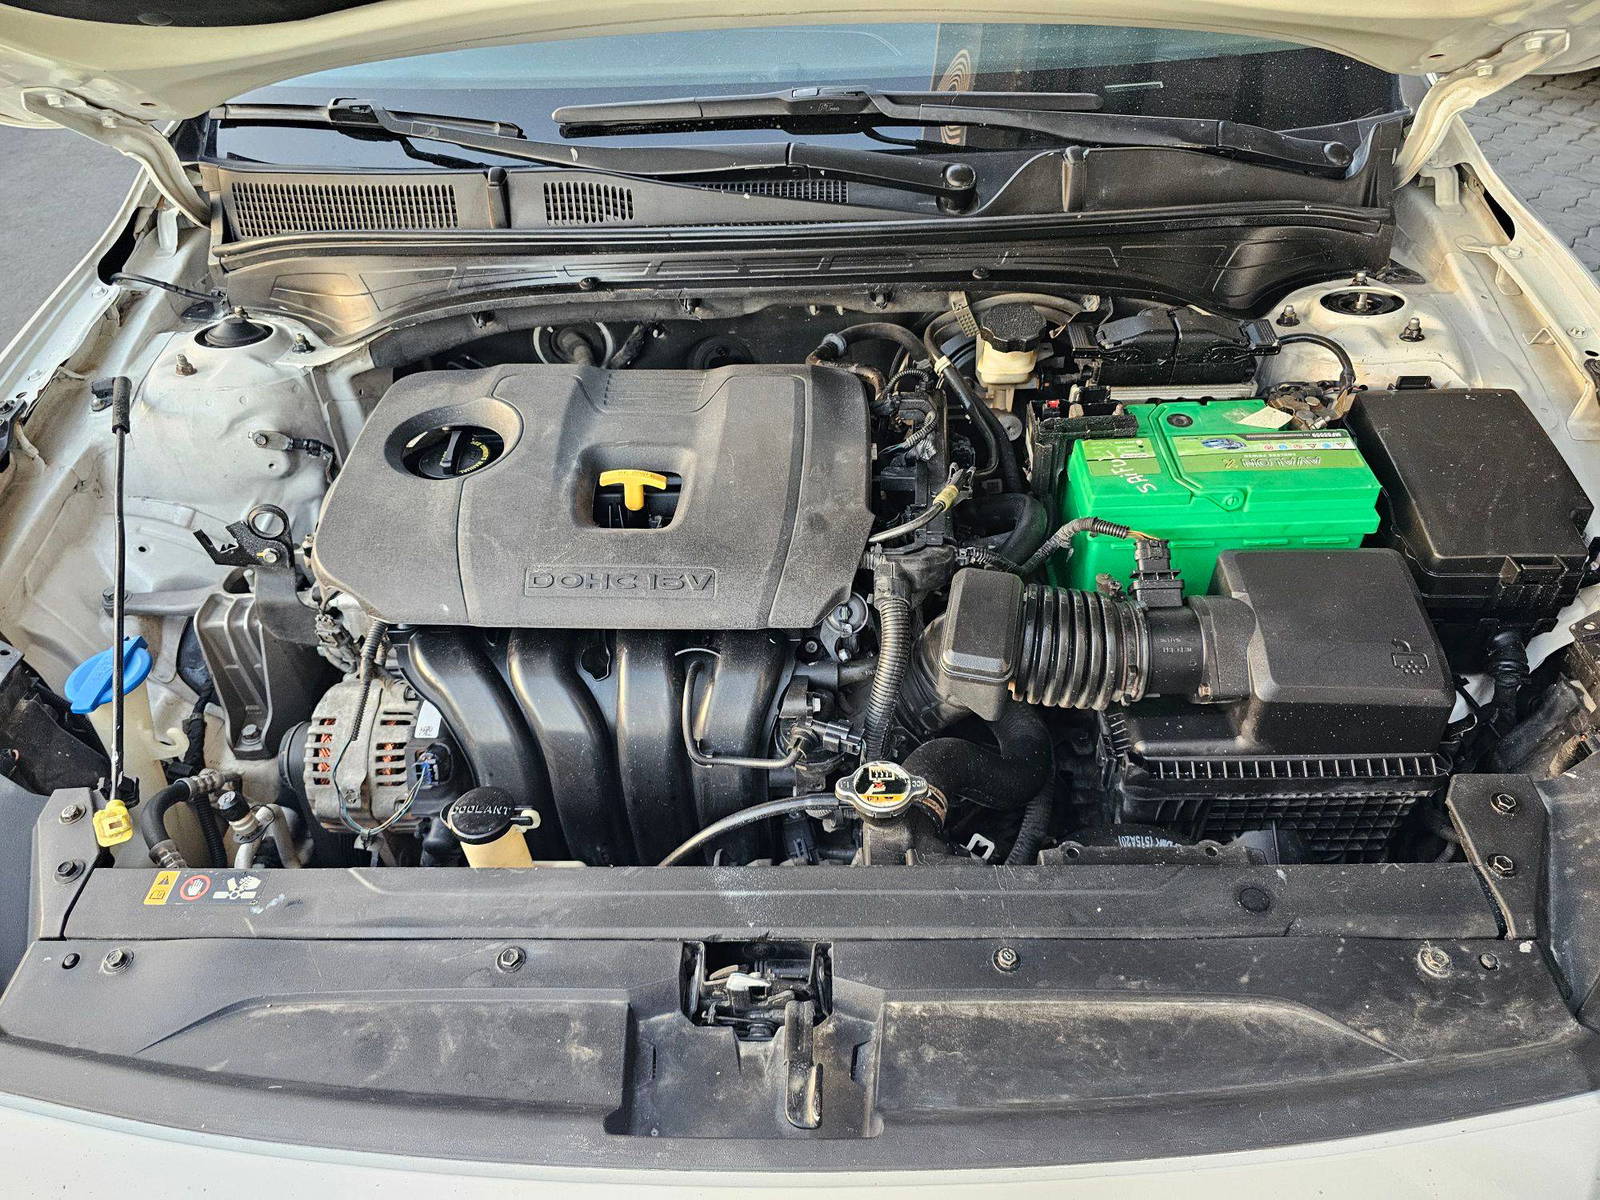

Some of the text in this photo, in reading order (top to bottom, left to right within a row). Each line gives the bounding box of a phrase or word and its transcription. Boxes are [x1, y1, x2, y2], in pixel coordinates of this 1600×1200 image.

[528, 573, 714, 591] DOHC 16V
[451, 805, 511, 815] COOLANT
